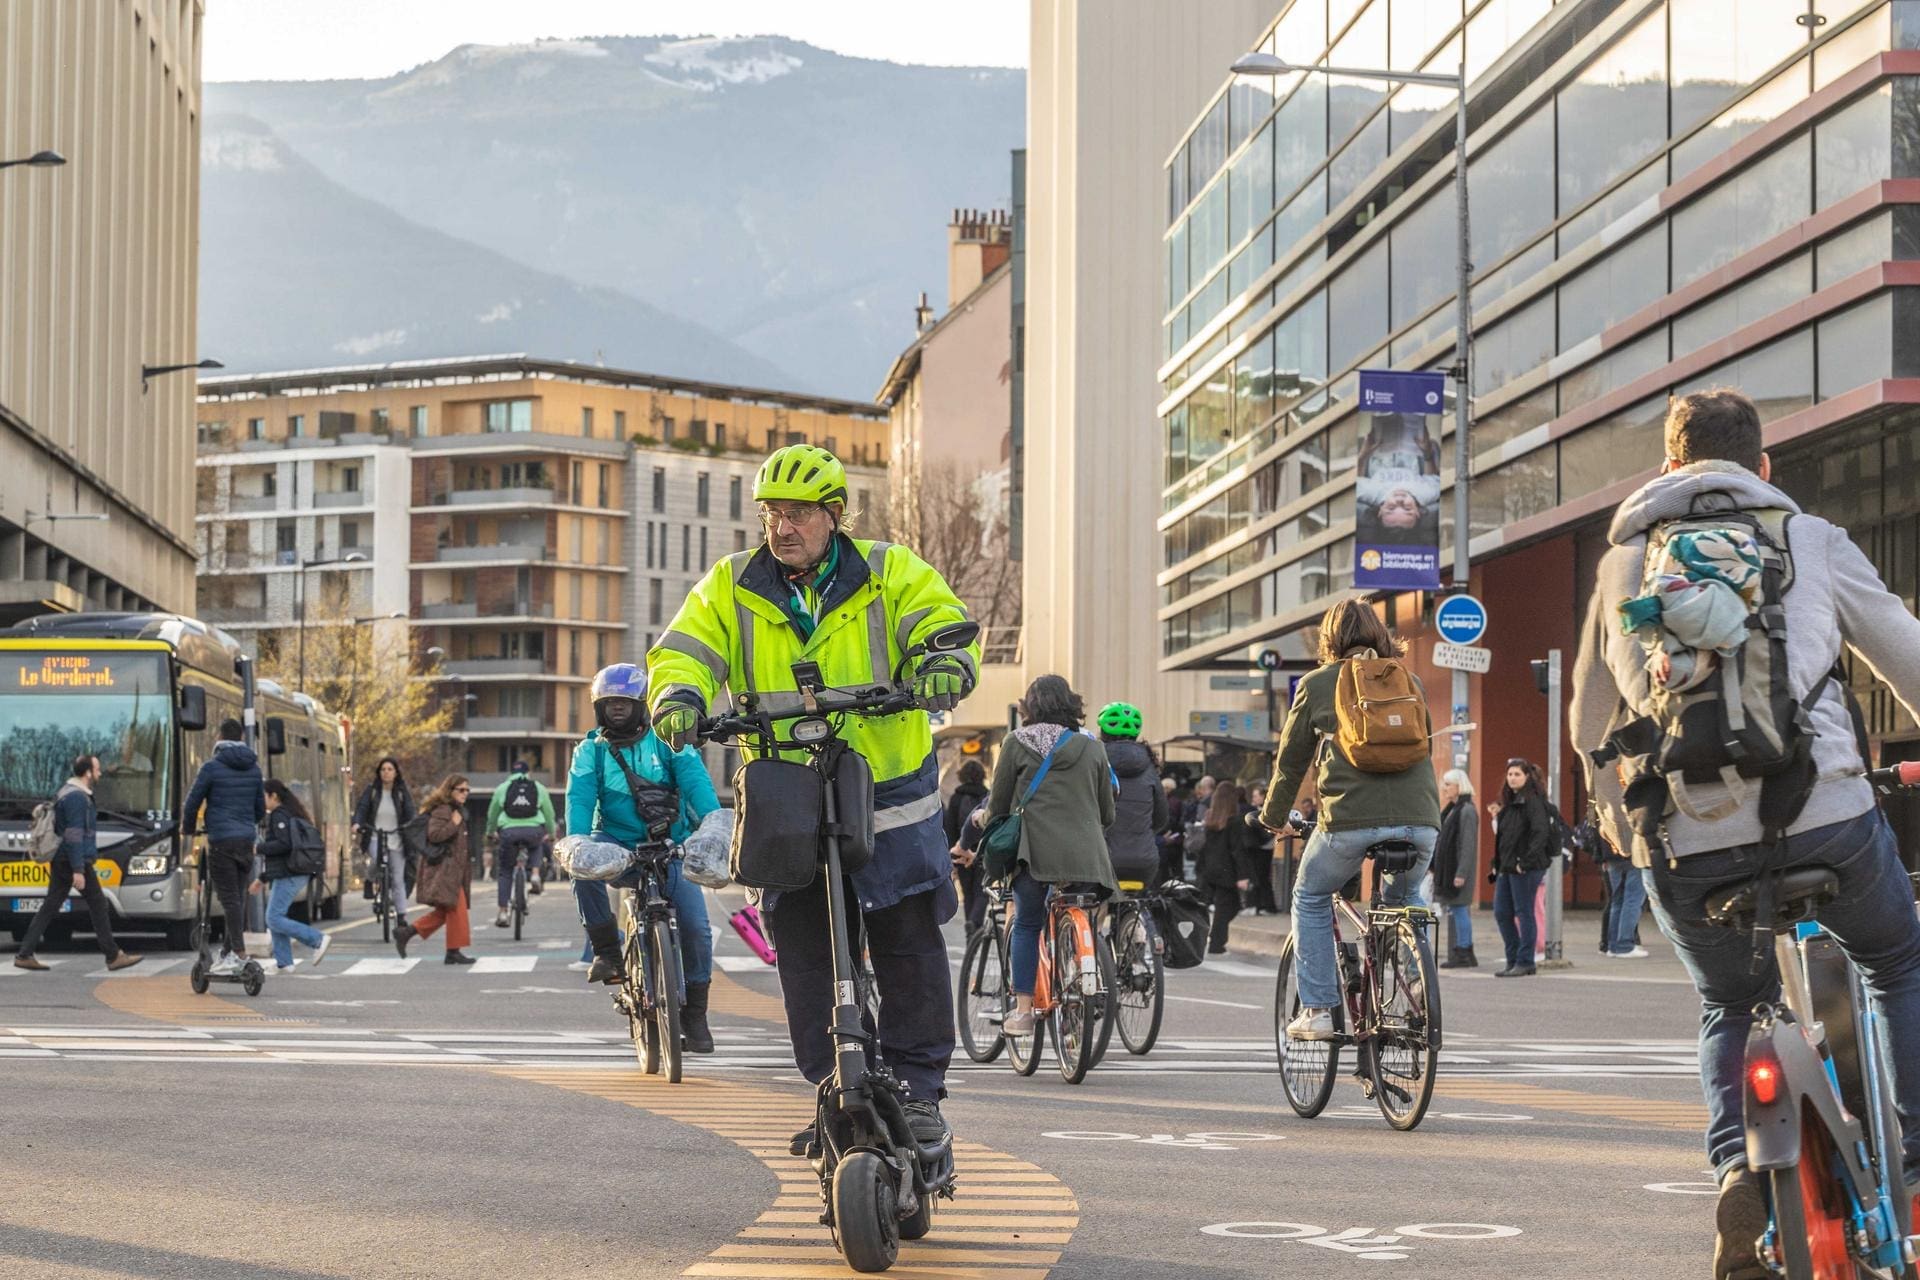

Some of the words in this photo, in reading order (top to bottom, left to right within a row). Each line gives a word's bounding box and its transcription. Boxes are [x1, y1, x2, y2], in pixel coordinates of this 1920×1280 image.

[1264, 654, 1276, 666] M
[20, 666, 39, 686] Le
[147, 809, 171, 821] 533
